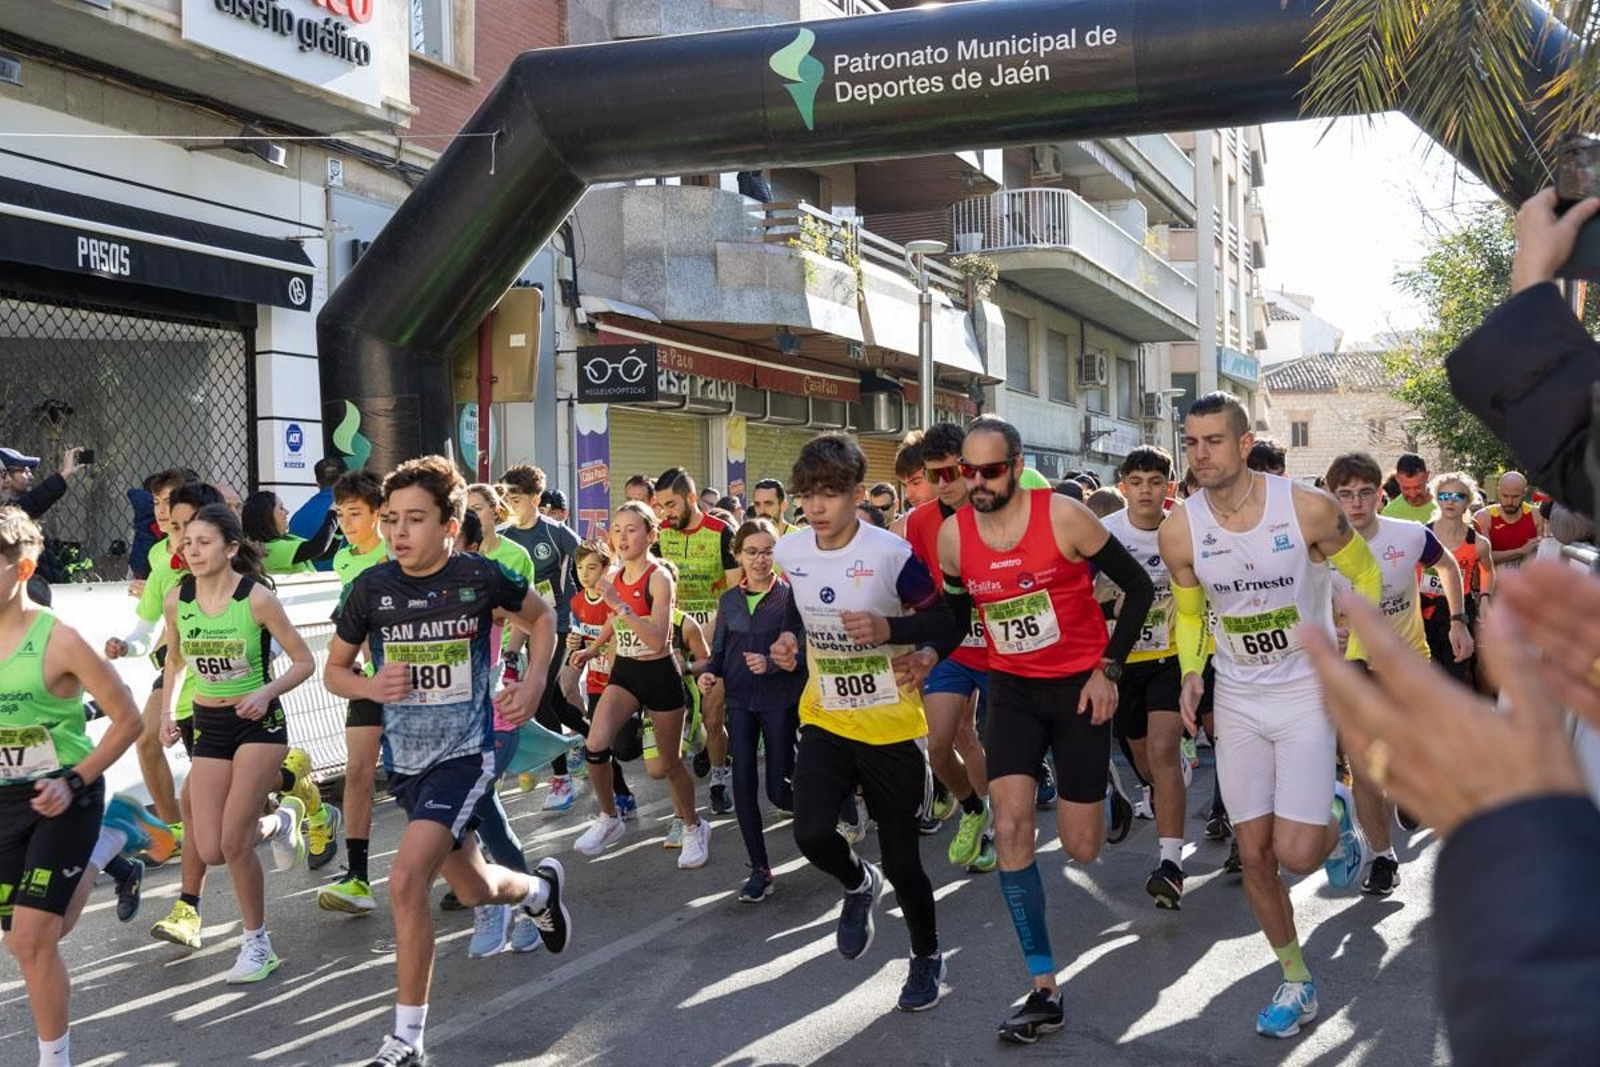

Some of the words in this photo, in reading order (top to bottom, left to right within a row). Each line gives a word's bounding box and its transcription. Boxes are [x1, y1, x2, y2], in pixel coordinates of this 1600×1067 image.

[298, 16, 371, 67] gráfico
[834, 46, 949, 75] Patronato
[957, 26, 1077, 61] Municipal
[1085, 25, 1117, 47] de
[834, 71, 945, 104] Deportes
[951, 68, 983, 90] de
[990, 60, 1051, 87] Jaén
[77, 236, 131, 276] PASOS
[1213, 583, 1231, 594] Da
[1233, 575, 1295, 592] Ernesto
[380, 624, 414, 641] SAN
[419, 615, 479, 639] ANTÓN
[998, 615, 1040, 642] 736
[1242, 628, 1289, 655] 680
[196, 657, 233, 675] 664
[834, 673, 877, 697] 808
